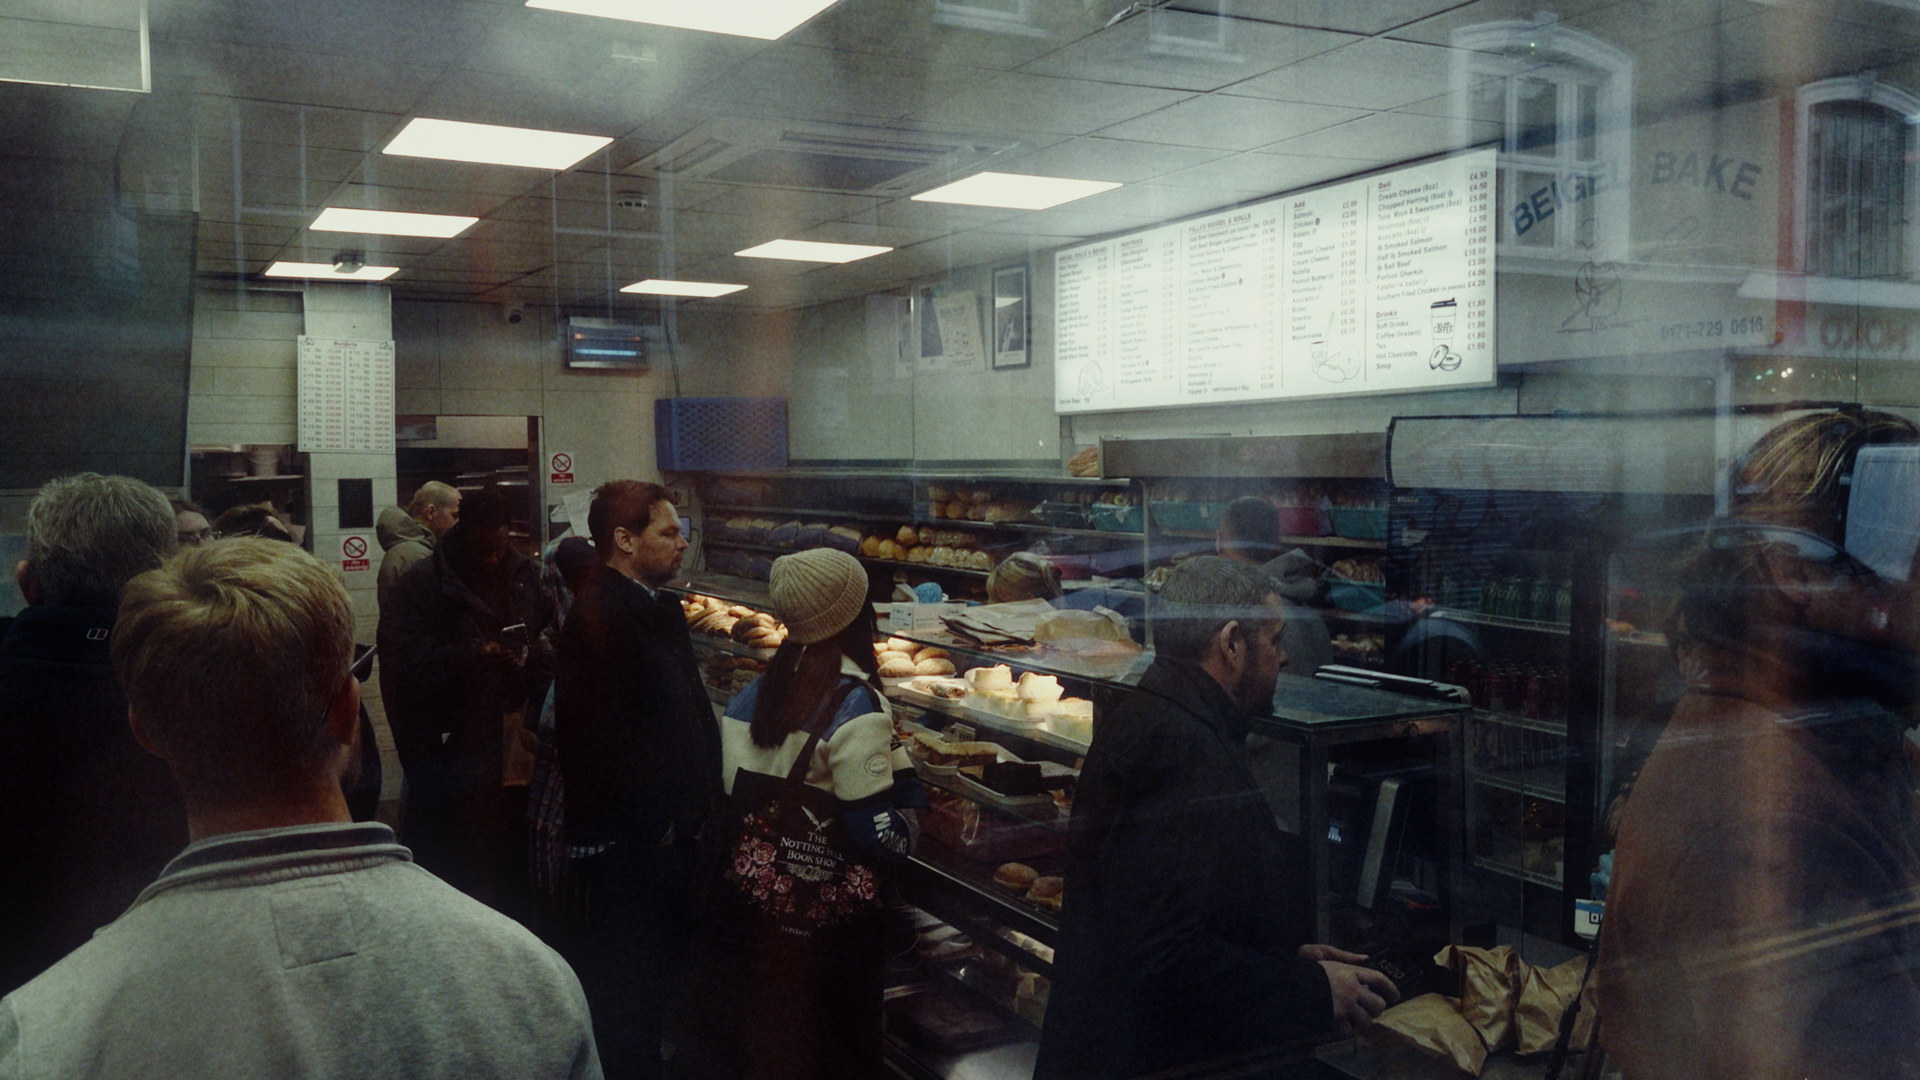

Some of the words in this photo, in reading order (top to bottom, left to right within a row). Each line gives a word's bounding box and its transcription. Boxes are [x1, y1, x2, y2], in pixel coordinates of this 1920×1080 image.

[1378, 180, 1391, 189] Deli
[1378, 191, 1397, 201] Cream
[1399, 185, 1421, 196] Cheese
[1423, 181, 1438, 192] (8oz)
[1469, 170, 1488, 180] £4.50
[1378, 199, 1404, 211] Chopped
[1406, 194, 1429, 206] Herring
[1430, 191, 1446, 202] (8oz)
[1469, 182, 1487, 191] £4.50
[1512, 158, 1622, 236] BEIGEL
[1652, 151, 1762, 201] BAKE
[1294, 200, 1305, 208] Add
[1393, 209, 1407, 218] Mayo
[1415, 202, 1444, 213] Sweetcorn
[1469, 192, 1487, 202] £5.00
[1469, 203, 1487, 213] £3.50
[1233, 213, 1251, 222] ROLLS
[1293, 210, 1312, 219] Salmon
[1468, 214, 1486, 223] £4.50
[1293, 219, 1314, 229] Chicken
[1384, 240, 1408, 249] Smoked
[1410, 235, 1433, 245] Salmon
[1465, 225, 1486, 235] £18.00
[1292, 240, 1303, 249] Egg
[1376, 253, 1389, 261] Half
[1397, 248, 1422, 257] Smoked
[1424, 243, 1447, 253] Salmon
[1468, 236, 1486, 245] £9.00
[1292, 247, 1314, 256] Cheddar
[1315, 244, 1335, 252] Cheese
[1292, 258, 1308, 266] Cream
[1311, 254, 1330, 263] Cheese
[1292, 267, 1310, 275] Nutella
[1376, 272, 1397, 280] Portion
[1400, 268, 1424, 277] Gherkin
[1468, 257, 1486, 266] £3.00
[1468, 269, 1486, 277] £4.00
[1376, 292, 1400, 300] Southern
[1417, 286, 1439, 294] Chicken
[1467, 279, 1485, 287] £4.20
[1292, 314, 1312, 322] Gherkin
[1376, 310, 1397, 318] Drinks
[1731, 316, 1763, 335] 0616
[1292, 332, 1322, 341] Mayonnaise
[1396, 329, 1422, 338] (Instant)
[1388, 350, 1418, 358] Chocolate
[807, 831, 827, 845] THE
[780, 836, 825, 855] NOTTING
[787, 849, 813, 863] BOOK
